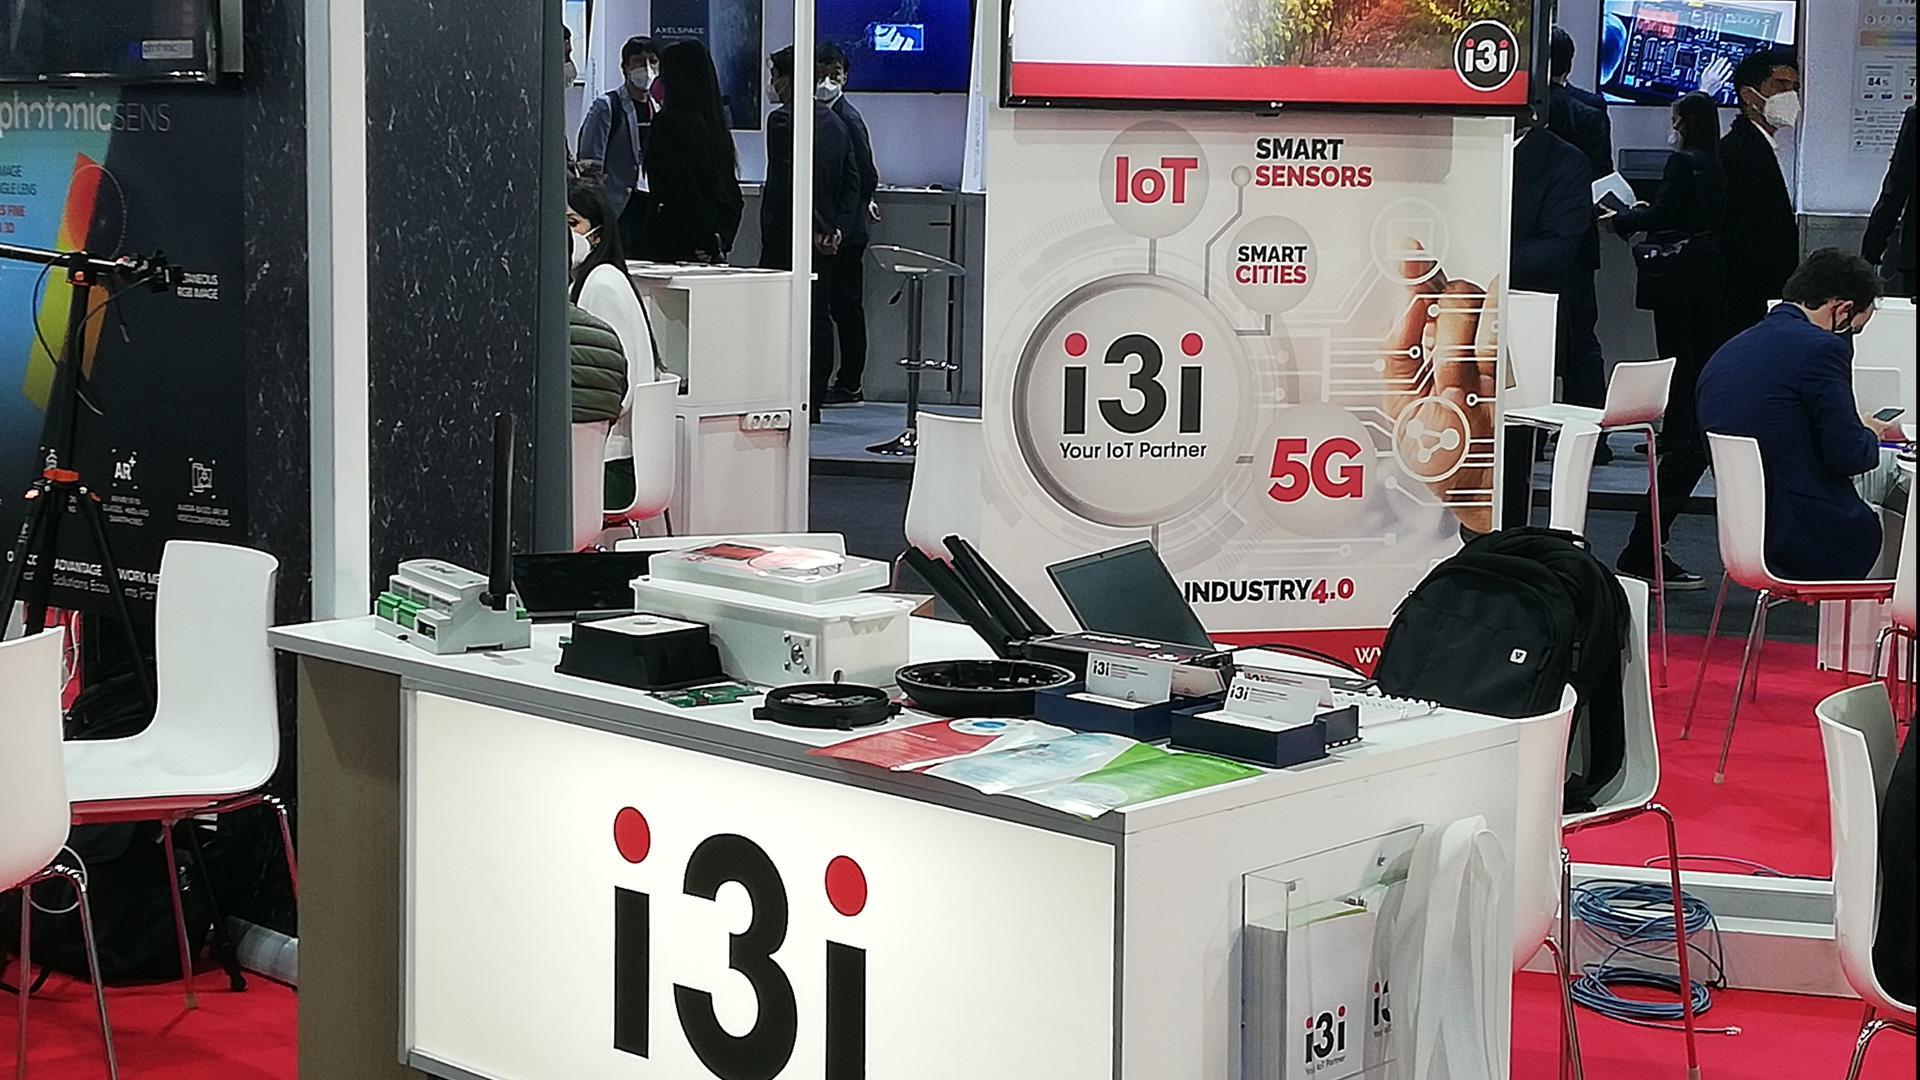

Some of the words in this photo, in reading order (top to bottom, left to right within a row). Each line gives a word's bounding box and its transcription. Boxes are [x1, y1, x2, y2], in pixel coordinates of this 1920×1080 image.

[655, 26, 705, 34] AXELSPACE
[1464, 38, 1509, 73] i3i
[1256, 138, 1344, 161] SMART
[1115, 156, 1199, 204] IoT
[1255, 165, 1373, 188] SENSORS
[1237, 245, 1308, 263] SMART
[1235, 264, 1307, 284] CITIES
[1063, 332, 1204, 435] i3i
[1059, 441, 1102, 459] Your
[1107, 441, 1134, 459] IoT
[1139, 440, 1207, 459] Partner
[1267, 437, 1364, 502] 5G
[53, 558, 103, 577] ADVANTAGE
[116, 567, 146, 584] WORK
[1184, 578, 1355, 604] INDUSTRY4.0
[1093, 660, 1110, 677] i3i
[1229, 685, 1250, 701] i3i
[613, 806, 868, 1080] i3i
[1305, 1005, 1346, 1065] i3i
